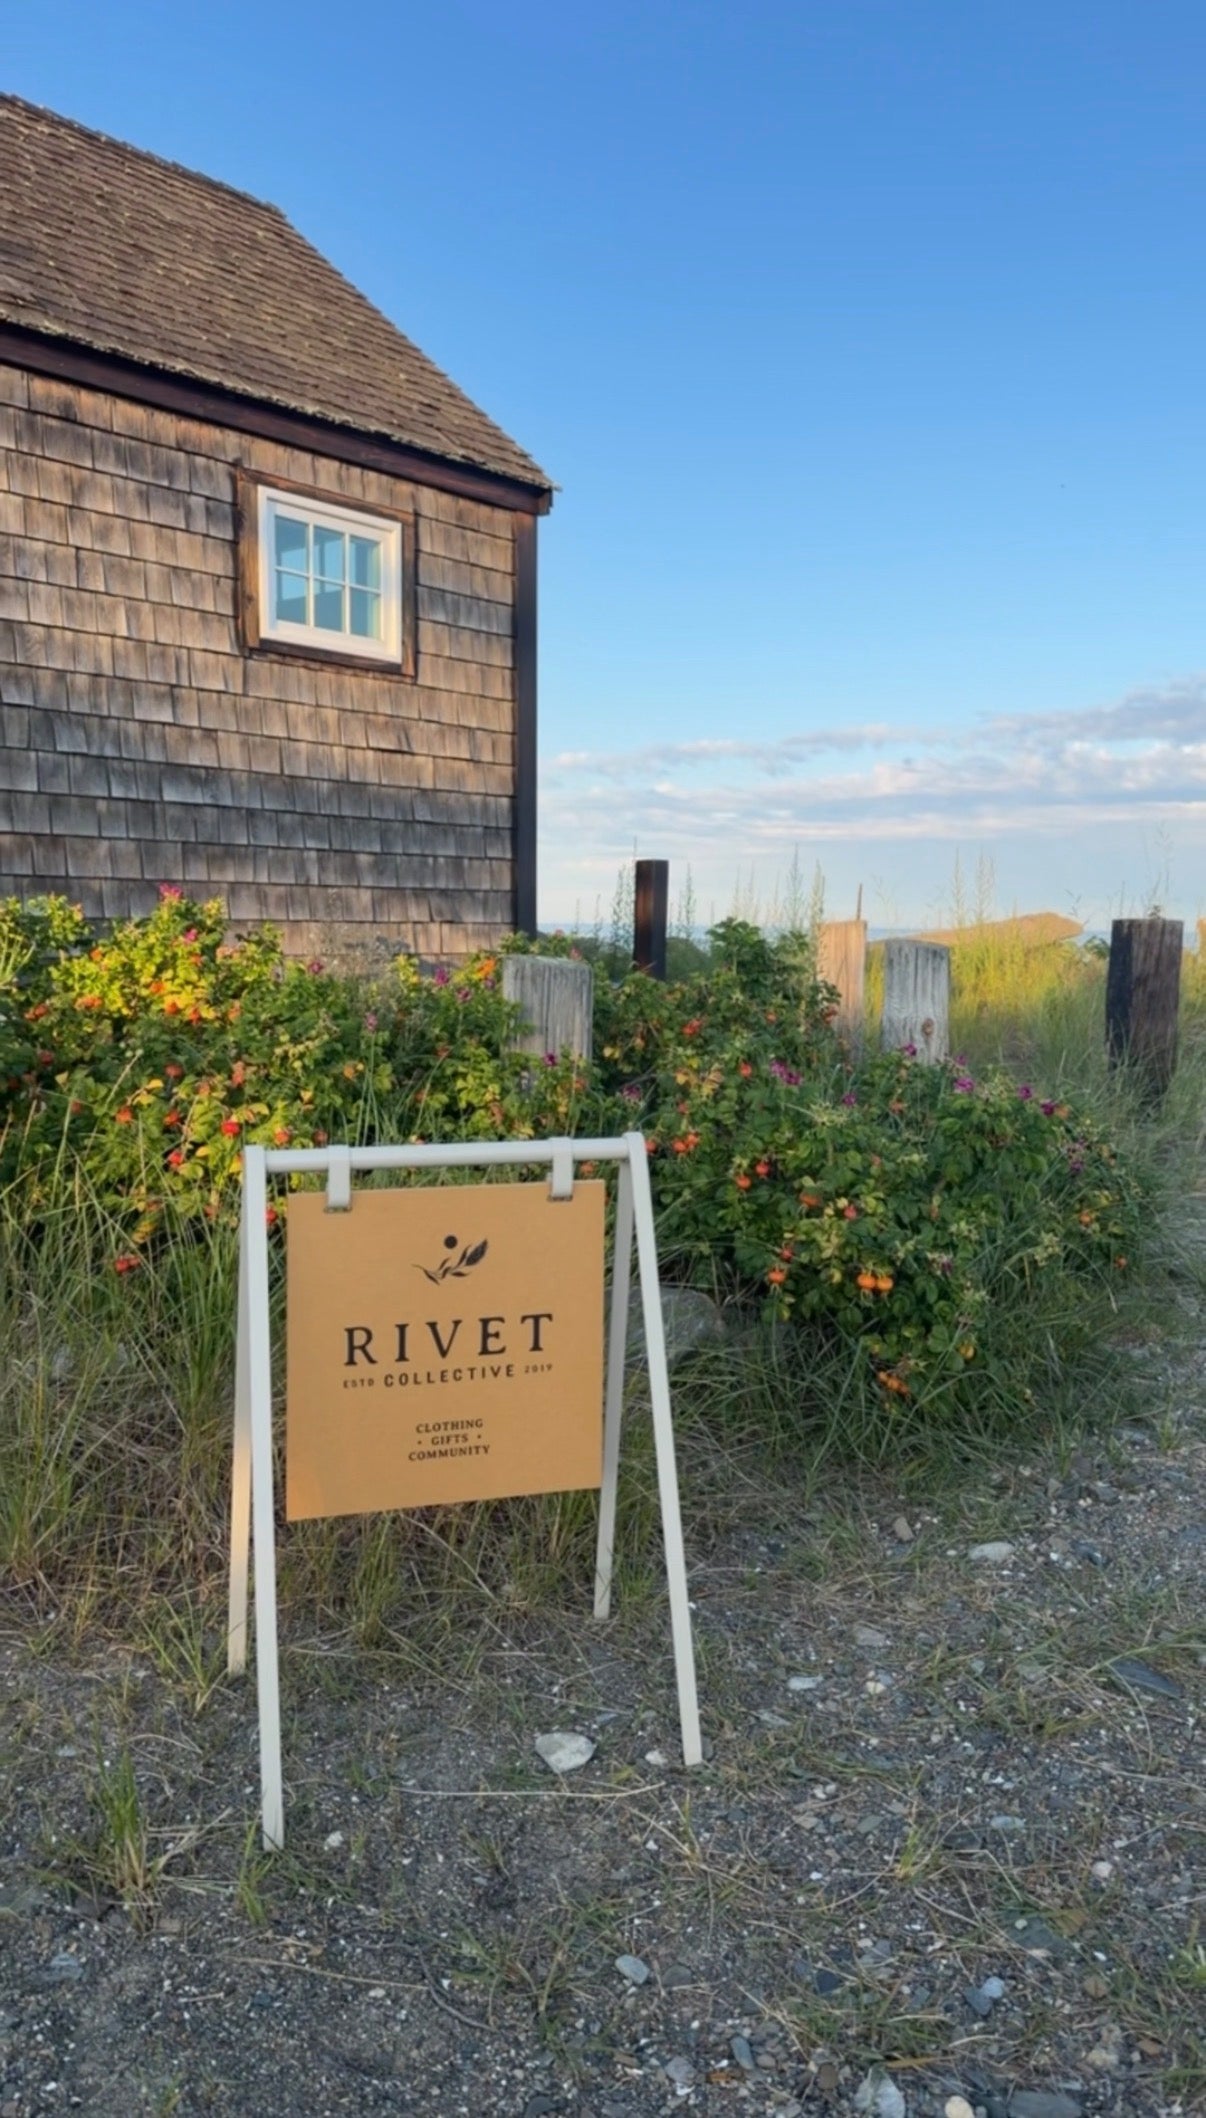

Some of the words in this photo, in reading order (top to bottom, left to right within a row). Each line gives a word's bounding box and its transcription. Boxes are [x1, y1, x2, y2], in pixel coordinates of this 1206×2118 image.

[343, 1313, 553, 1367] RIVET
[343, 1378, 375, 1389] ESTD
[384, 1364, 515, 1388] COLLECTIVE
[416, 1418, 484, 1434] CLOTHING
[431, 1433, 469, 1446] GIFTS
[408, 1444, 490, 1461] COMMUNITY
